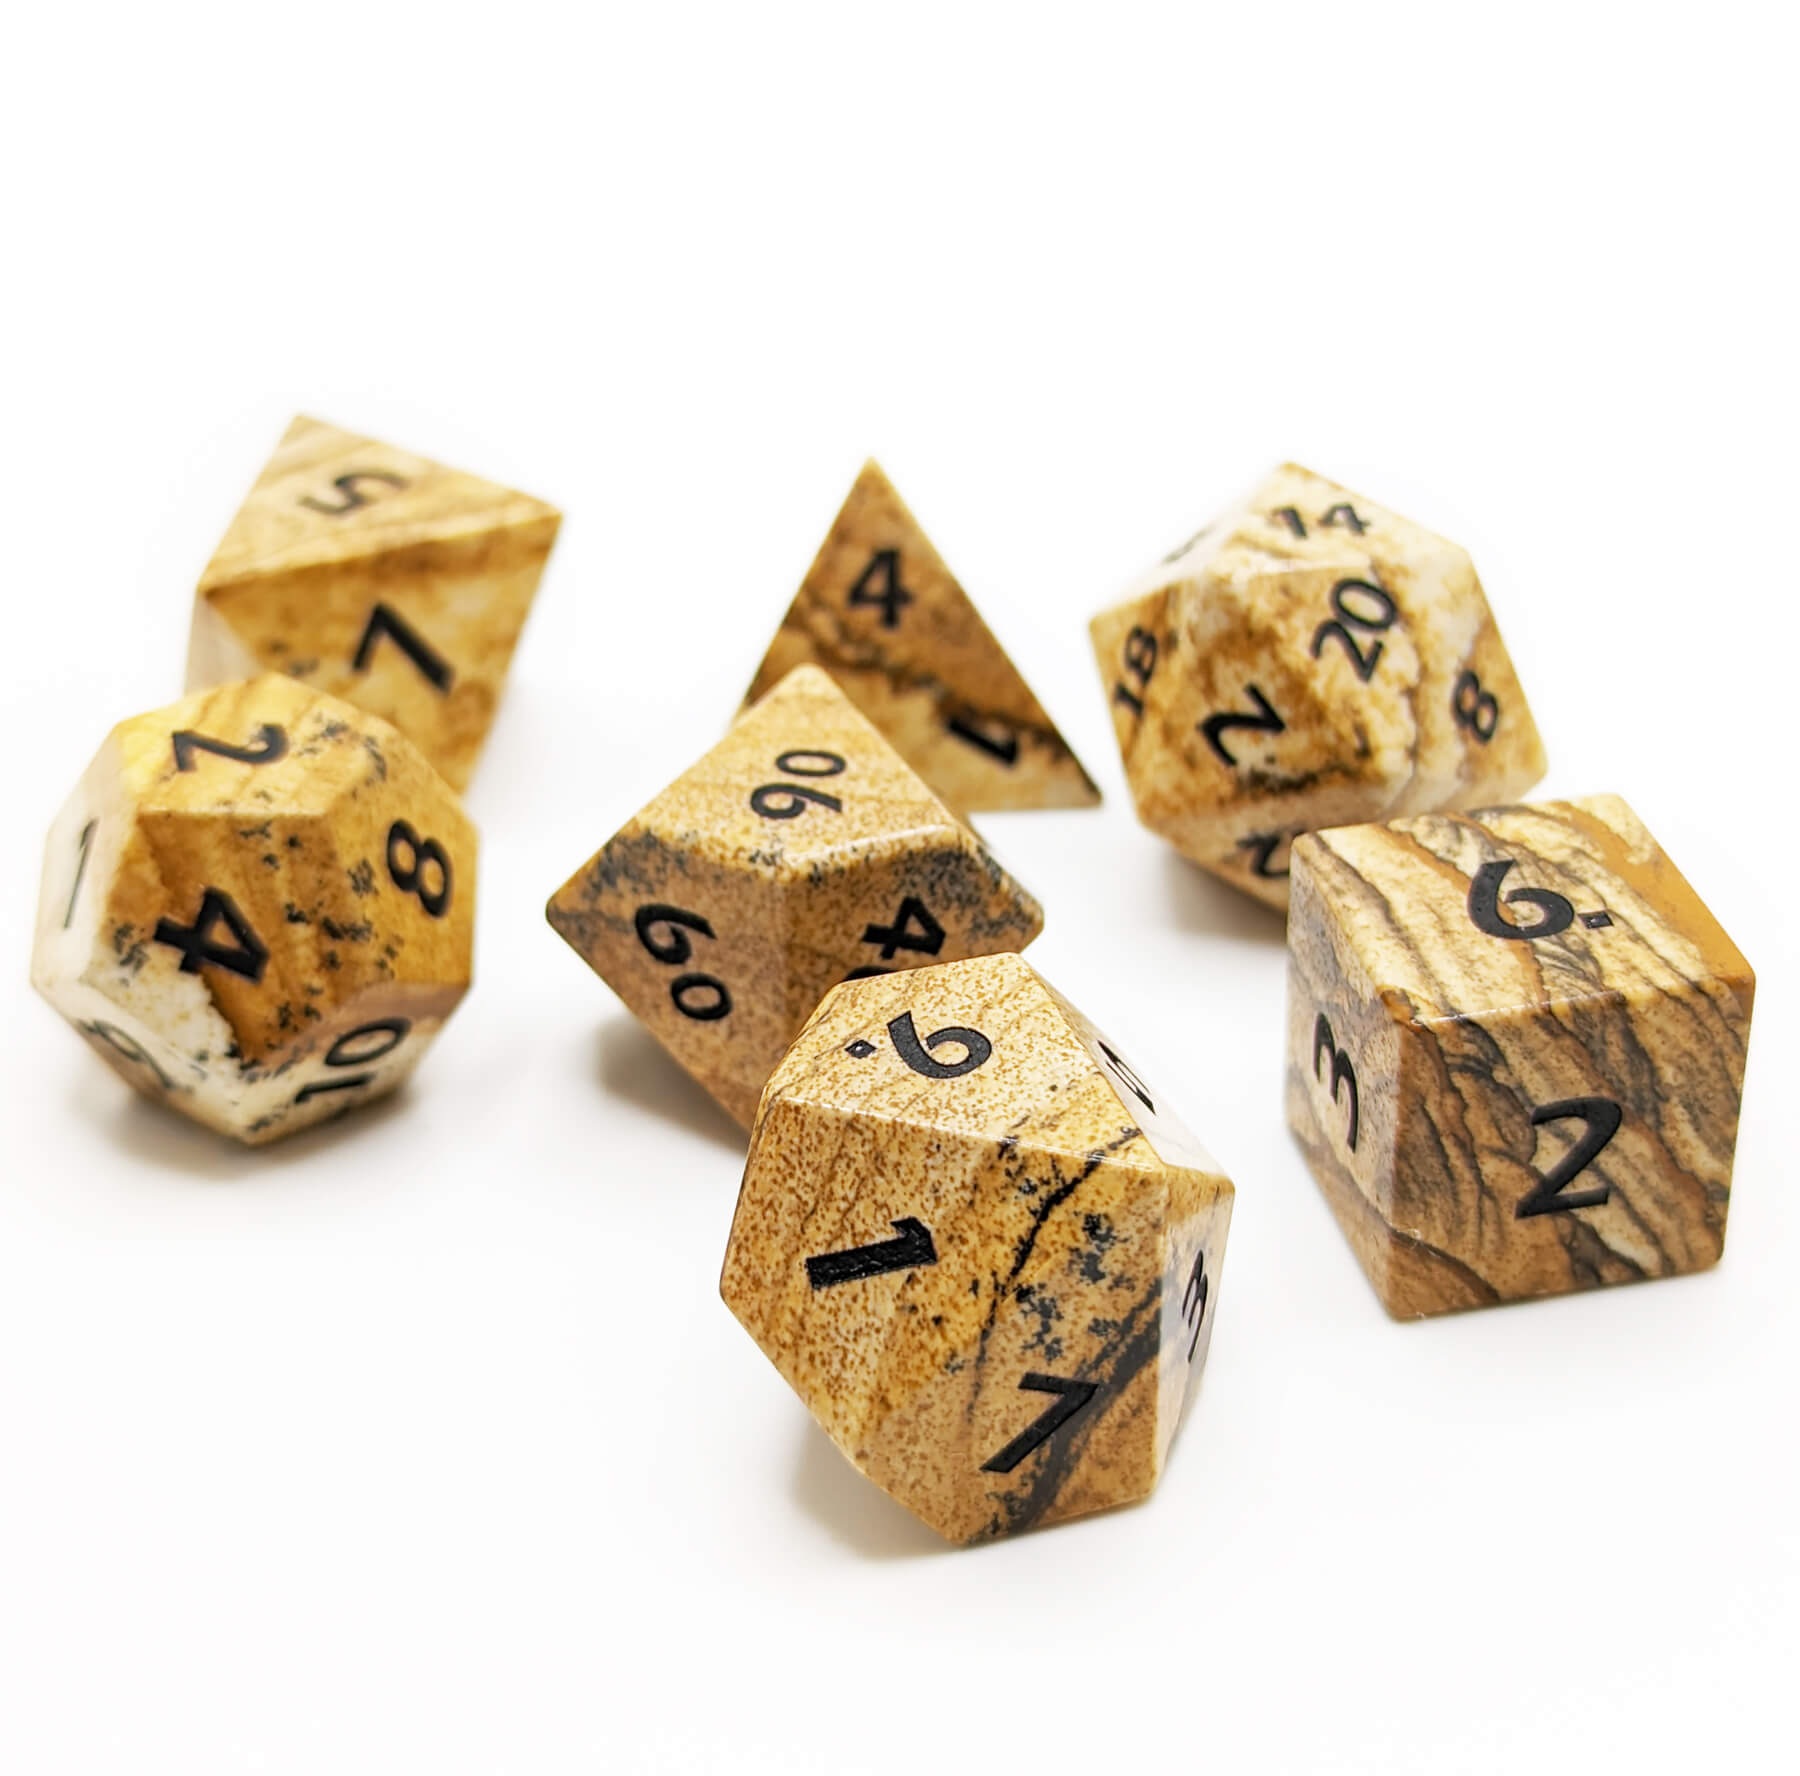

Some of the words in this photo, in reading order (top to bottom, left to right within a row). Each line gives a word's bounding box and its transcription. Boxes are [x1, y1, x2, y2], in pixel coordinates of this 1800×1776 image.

[302, 470, 404, 516] 5
[1274, 502, 1371, 539] 14
[849, 549, 914, 629] 4
[1311, 578, 1397, 682] 20
[352, 603, 454, 693] 7
[1114, 626, 1159, 718] 18
[171, 724, 288, 773] 2
[947, 713, 1021, 768] 1
[1196, 683, 1286, 766] 2
[1453, 669, 1499, 744] 8
[63, 819, 98, 929] 1
[386, 820, 453, 916] 8
[152, 886, 269, 983] 4
[844, 896, 946, 982] 4
[295, 1016, 410, 1103] 10
[1313, 1013, 1358, 1154] 3
[1516, 1097, 1622, 1218] 2
[806, 1216, 937, 1290] 1
[1182, 1249, 1210, 1363] 3
[980, 1372, 1099, 1473] 7
